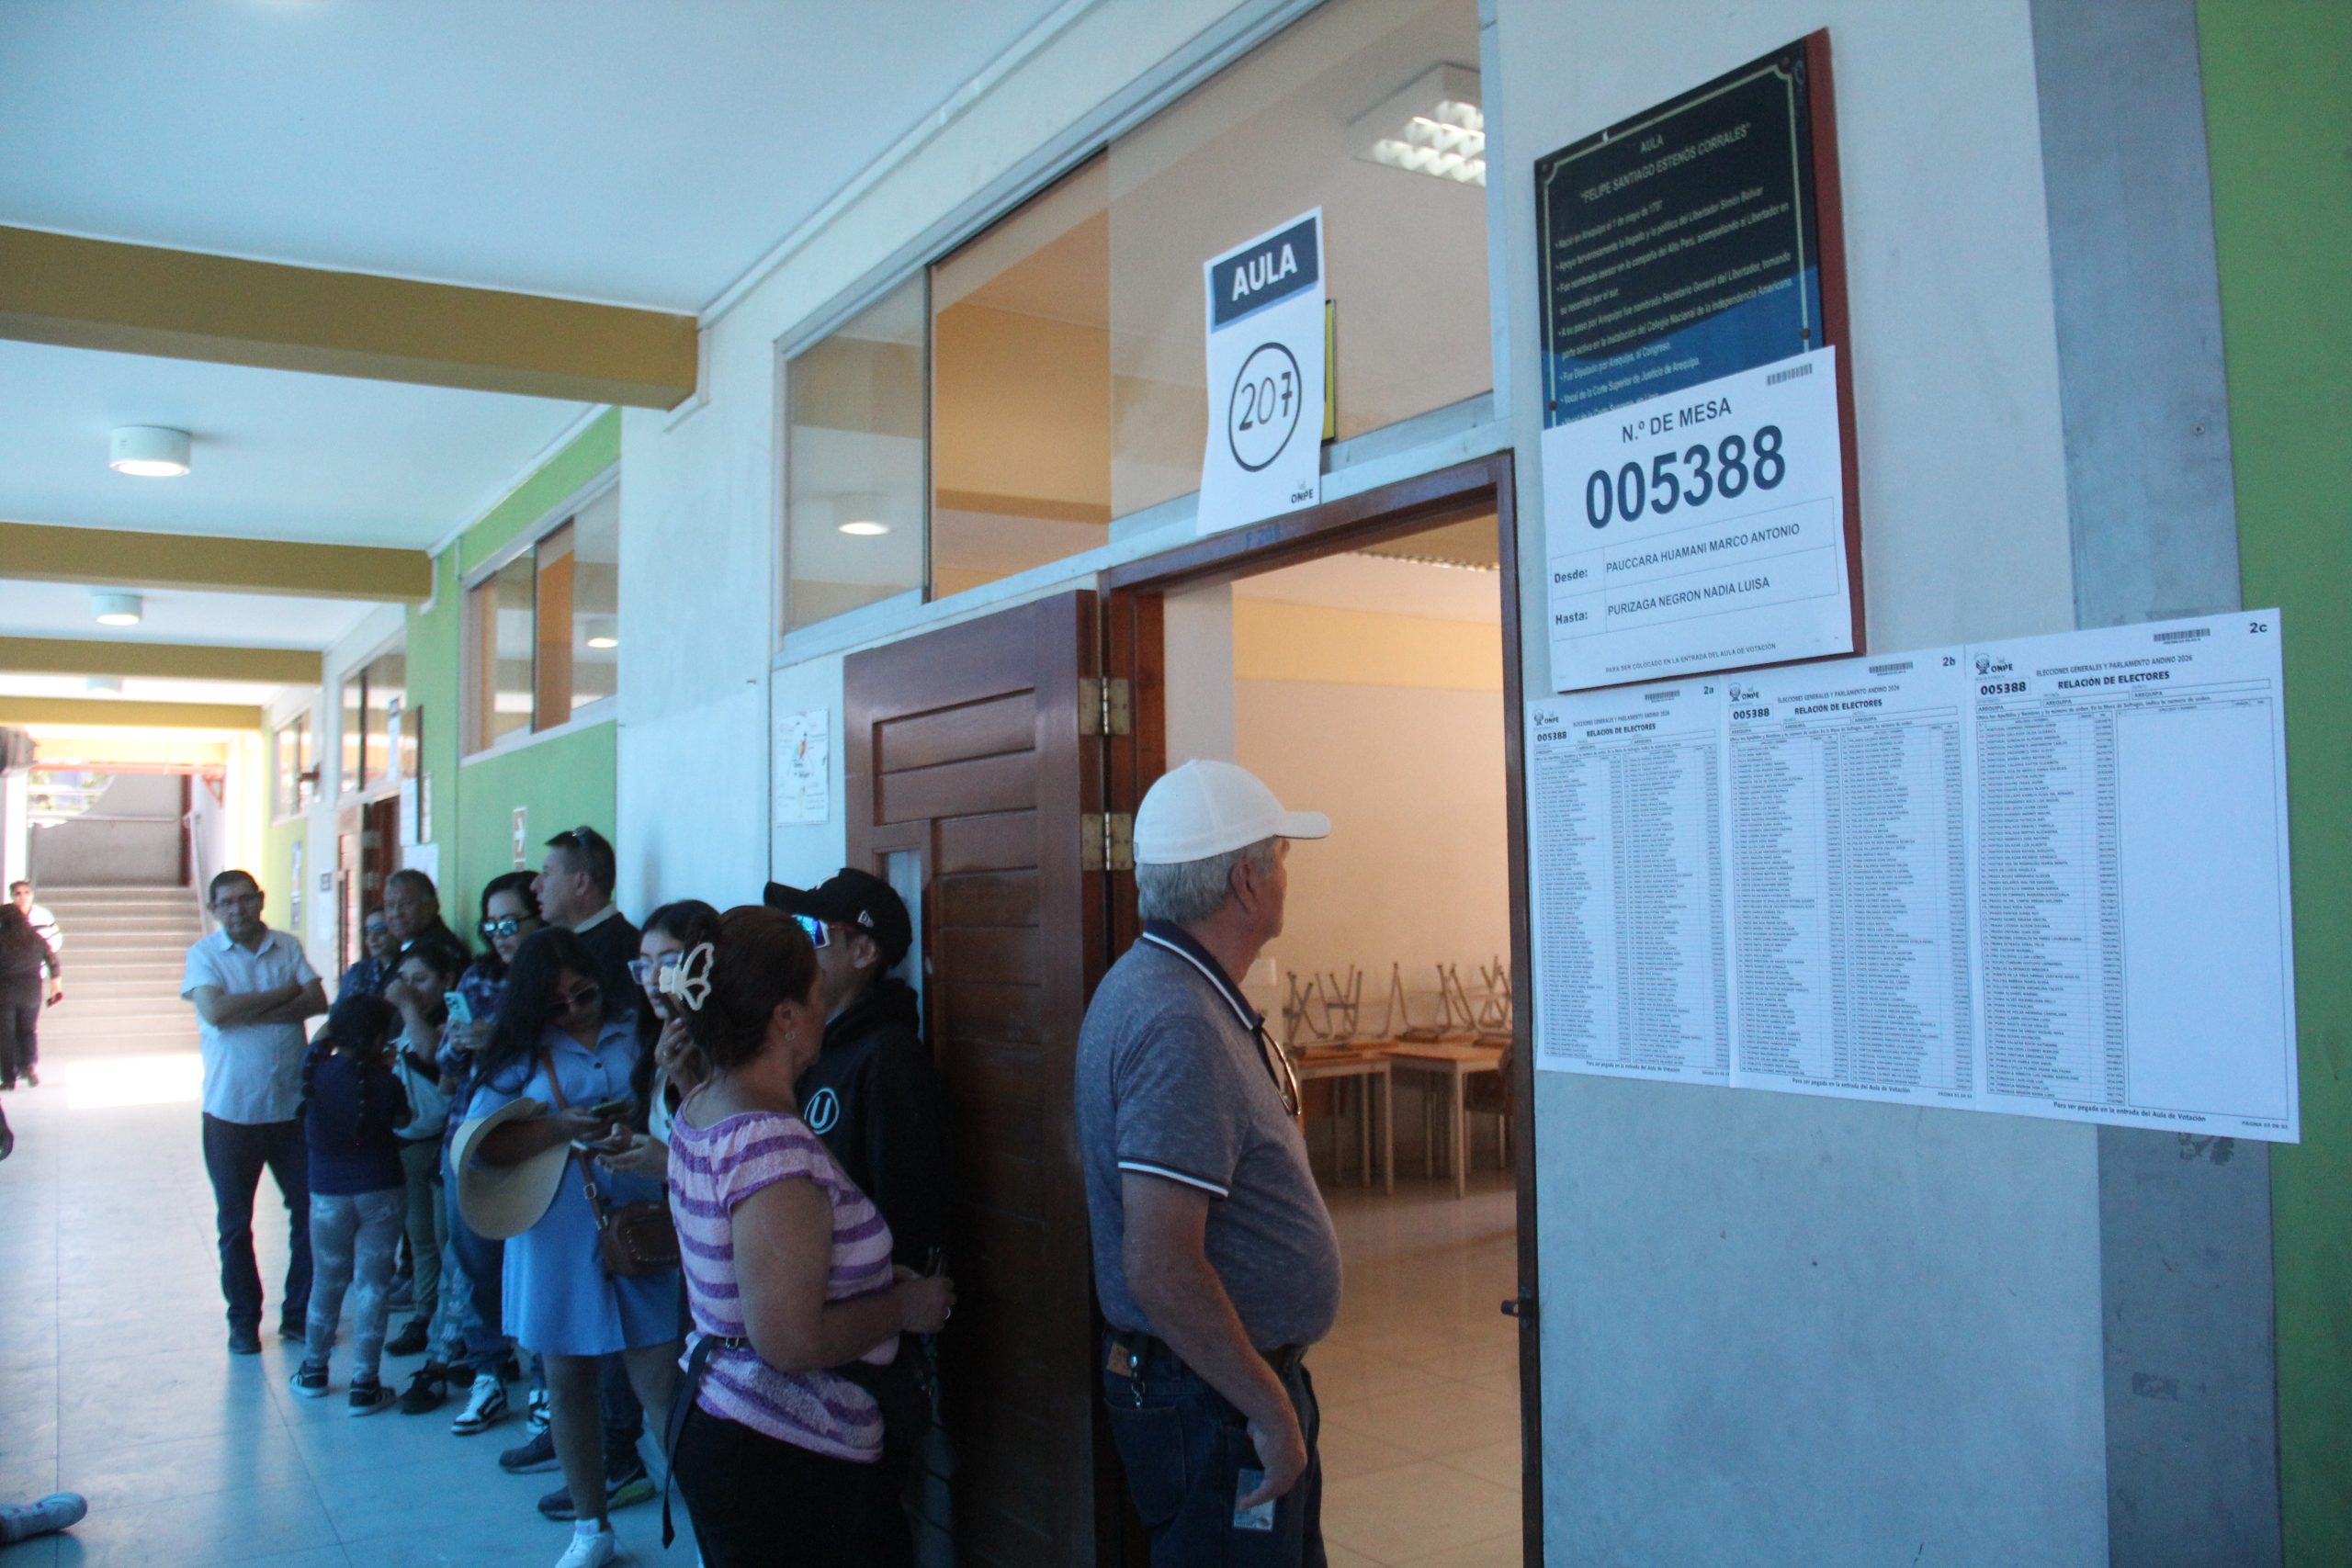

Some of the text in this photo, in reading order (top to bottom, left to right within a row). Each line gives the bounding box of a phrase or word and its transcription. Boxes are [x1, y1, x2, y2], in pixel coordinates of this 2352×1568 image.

[1640, 132, 1663, 155] AULA
[1612, 162, 1655, 192] SANTIAGO
[1232, 243, 1298, 301] AULA
[1238, 371, 1293, 431] 207
[1650, 412, 1673, 435] DE
[1679, 396, 1731, 428] MESA
[1585, 422, 1786, 530] 005388
[1291, 489, 1314, 503] ONPE
[1605, 523, 1800, 573] PAUCCARA HUAMANI MARCO ANTONIO
[1554, 567, 1588, 583] Desde:
[1608, 577, 1770, 615] PURIZAGA NEGRON NADIA LUISA
[1555, 610, 1588, 625] Hasta:
[2249, 620, 2267, 634] 2c
[1632, 660, 1661, 669] COLOCADO
[1680, 653, 1706, 662] ENTRADA
[1720, 649, 1736, 657] AULA
[1942, 656, 1955, 667] 2b
[2036, 667, 2069, 676] ELECCIONES
[2070, 663, 2102, 673] GENERALES
[2109, 660, 2150, 670] PARLAMENTO
[2152, 657, 2176, 666] ANDINO
[2177, 655, 2192, 663] 2026
[1991, 662, 2013, 672] ONPE
[2103, 675, 2115, 684] DE
[2118, 671, 2169, 683] ELECTORES
[1703, 684, 1713, 694] 2a
[1834, 688, 1866, 697] PARLAMENTO
[1868, 685, 1886, 694] ANDINO
[1981, 681, 2026, 694] 005388
[1741, 691, 1758, 700] ONPE
[1830, 703, 1839, 711] DE
[1841, 698, 1882, 709] ELECTORES
[1733, 707, 1770, 720] 005388
[1623, 722, 1656, 732] ELECTORES
[1537, 730, 1566, 742] 005388
[2077, 1103, 2098, 1112] pegada
[2116, 1107, 2139, 1115] entrada
